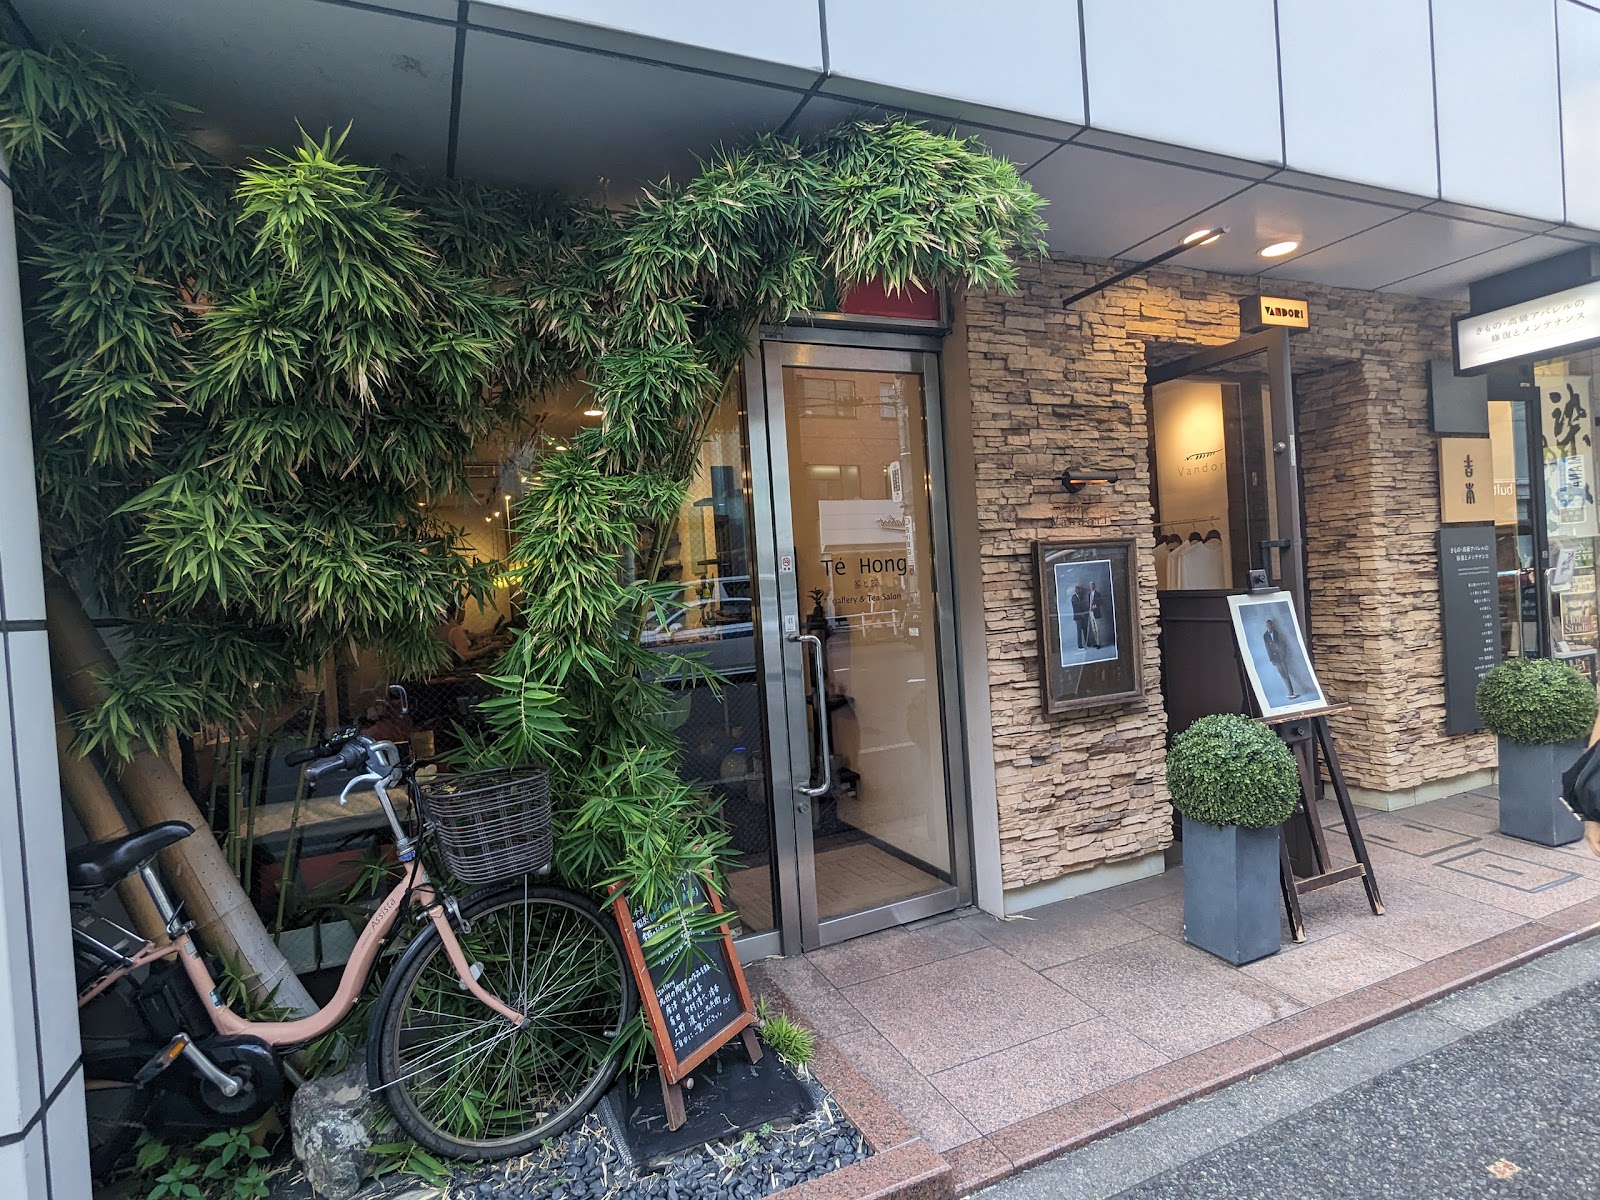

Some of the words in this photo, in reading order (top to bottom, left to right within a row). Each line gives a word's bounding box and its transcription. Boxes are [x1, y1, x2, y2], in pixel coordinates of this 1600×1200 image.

[1264, 306, 1304, 319] VANDORI
[820, 557, 846, 576] Té
[859, 557, 907, 576] Hong
[867, 594, 880, 602] Tea
[881, 592, 902, 600] Salon
[371, 898, 396, 930] Assista
[656, 980, 676, 997] Gallery
